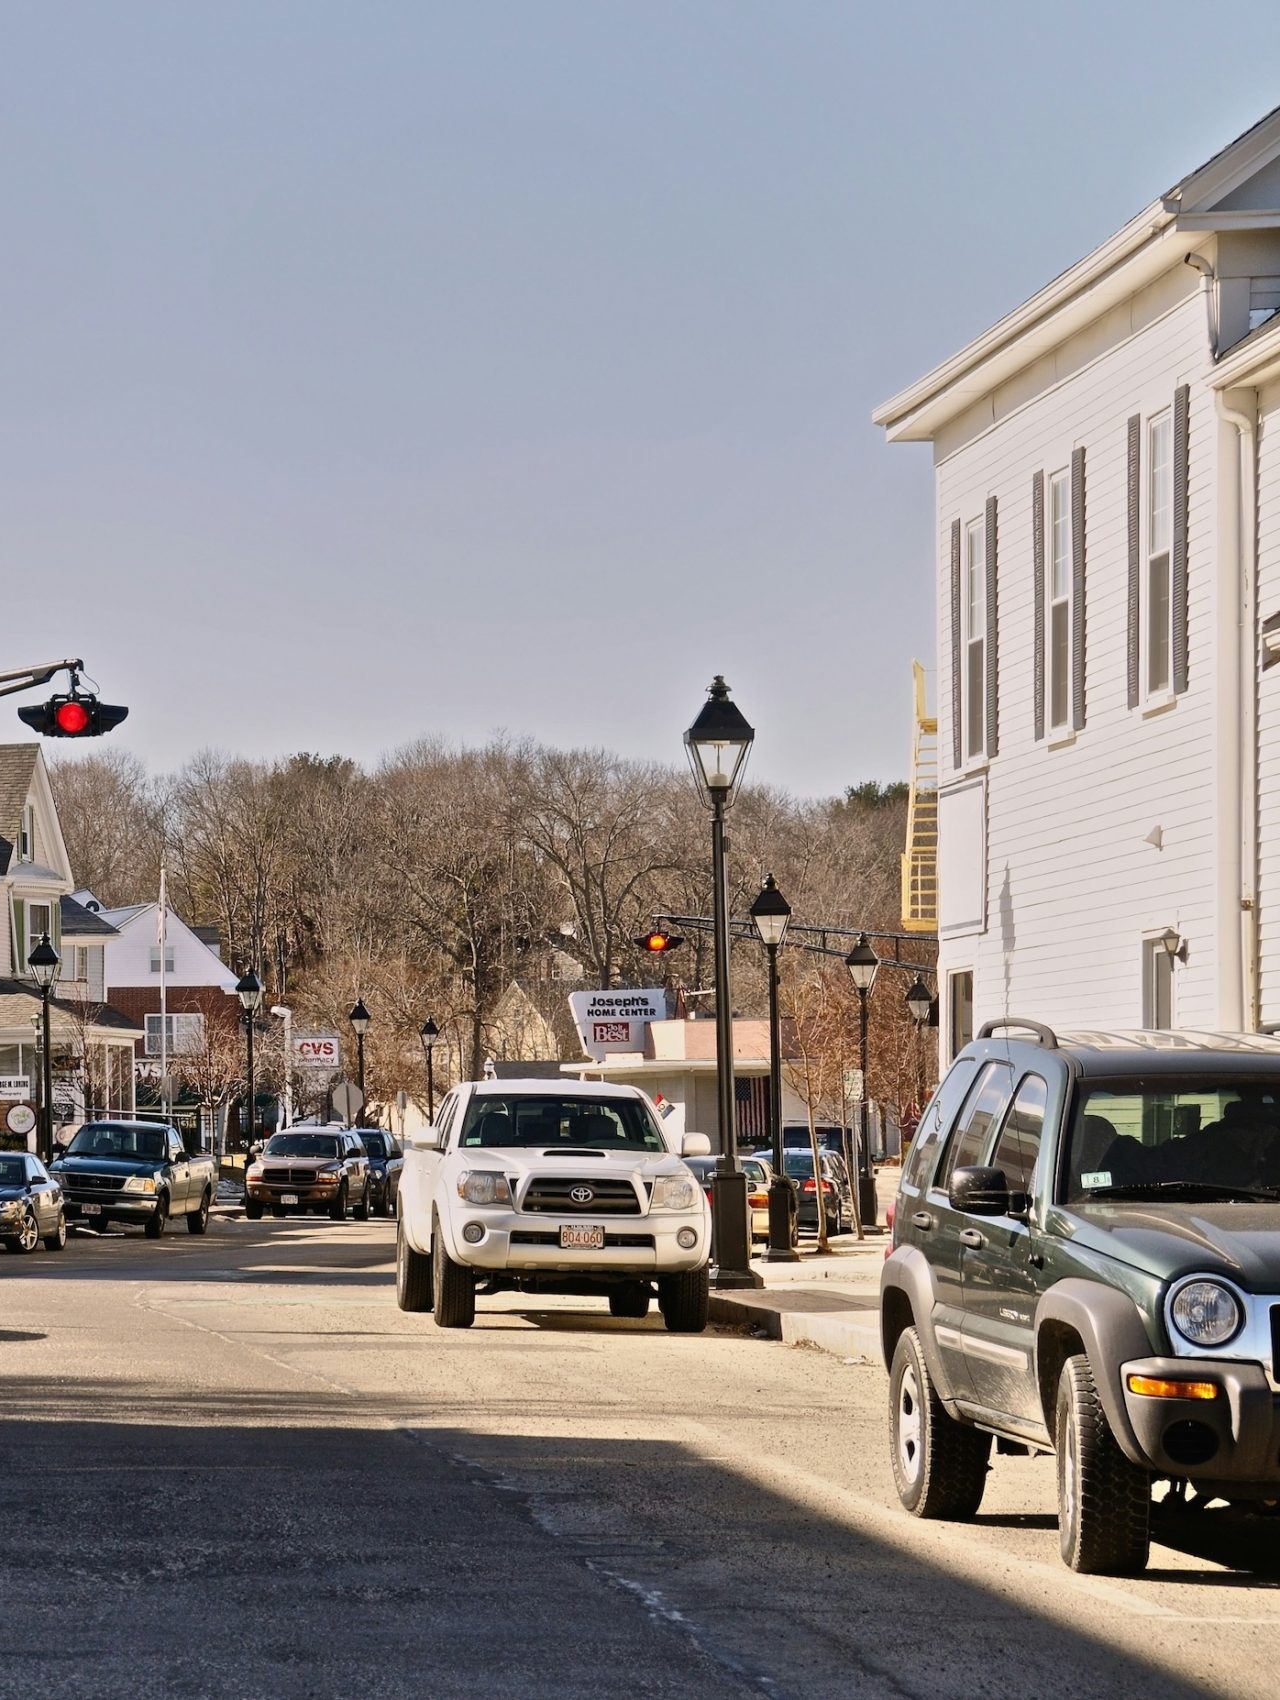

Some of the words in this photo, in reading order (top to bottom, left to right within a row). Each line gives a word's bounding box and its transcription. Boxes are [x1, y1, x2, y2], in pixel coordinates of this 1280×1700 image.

[587, 1008, 617, 1017] HOME
[619, 1008, 656, 1017] CENTER
[594, 1026, 629, 1041] Best
[299, 1042, 334, 1056] CVS
